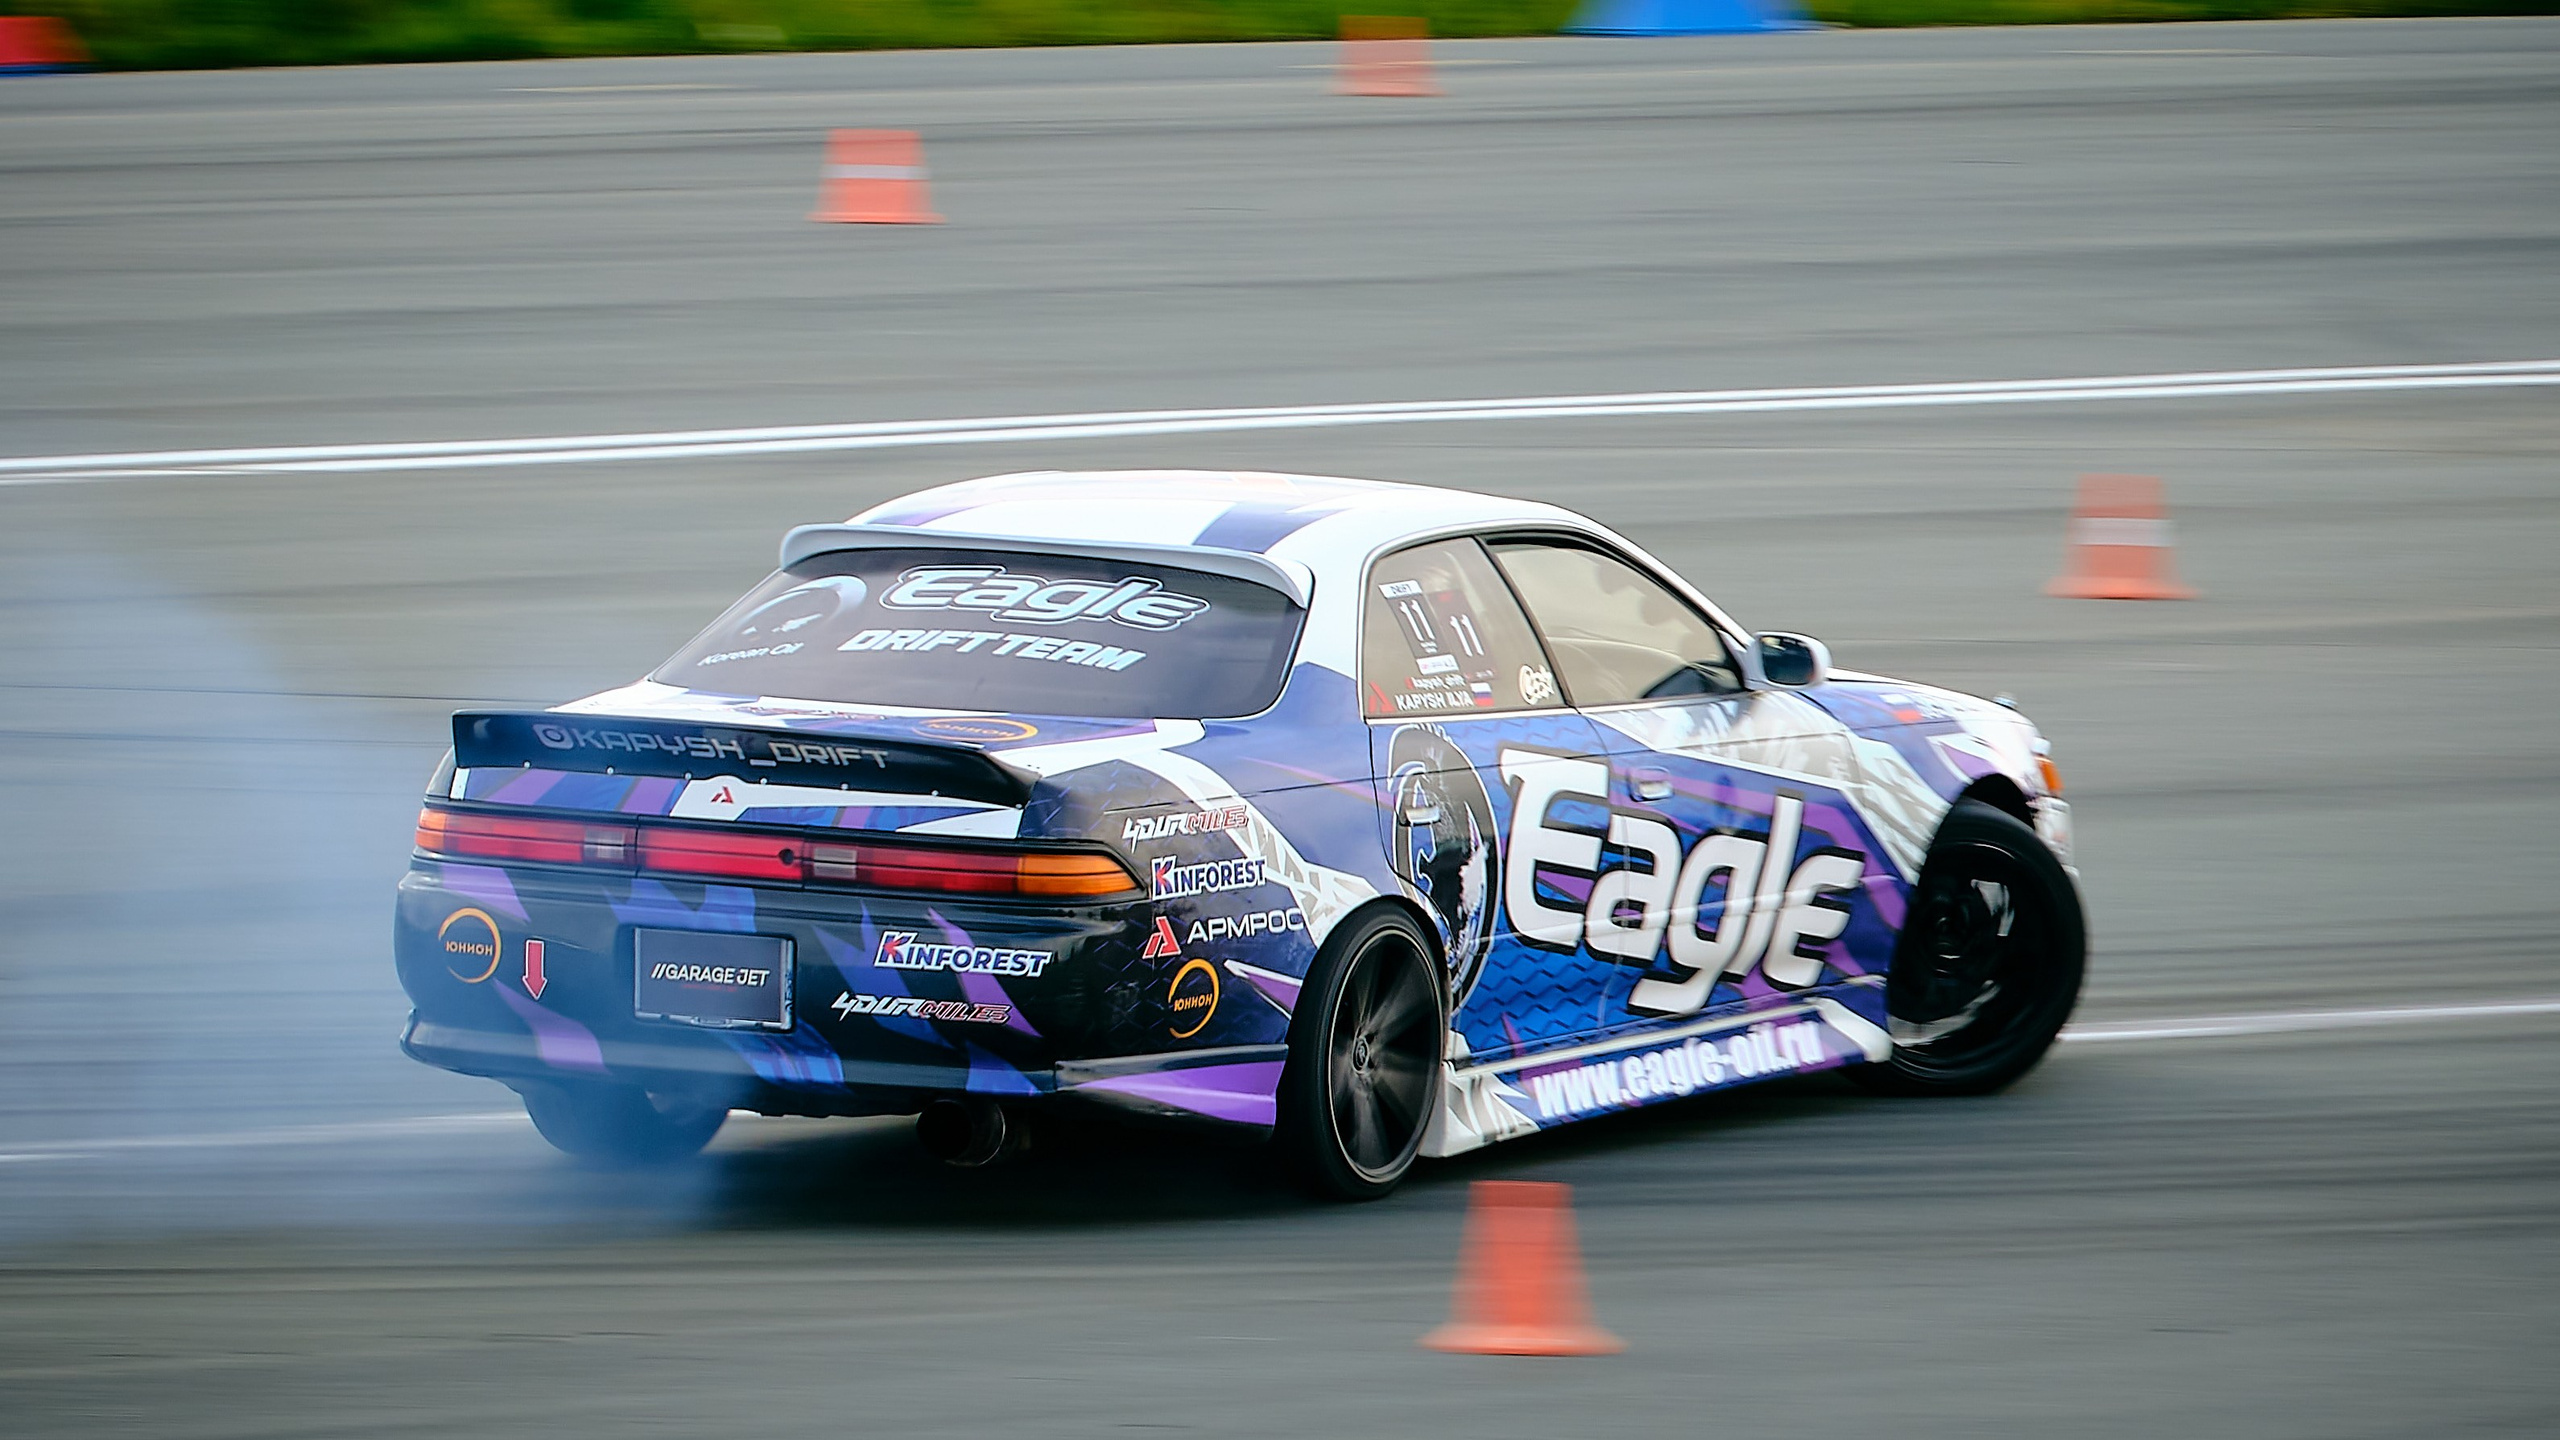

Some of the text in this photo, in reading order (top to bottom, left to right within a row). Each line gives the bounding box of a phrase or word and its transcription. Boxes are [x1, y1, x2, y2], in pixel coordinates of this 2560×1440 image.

[881, 566, 1209, 630] Eagle
[1399, 599, 1435, 641] 11
[1450, 614, 1484, 657] 11
[837, 629, 1146, 671] DRIFT TEAM
[1395, 690, 1475, 710] KAPYSH ILYA
[570, 727, 888, 768] KAPYSH_DRIFT
[1152, 856, 1267, 900] KINFOREST
[1499, 744, 1866, 1017] Eagle
[445, 940, 493, 956] ЮНИОН
[876, 932, 1051, 976] KINFOREST
[736, 968, 771, 987] JET
[1174, 993, 1213, 1012] ЮНИОН
[1533, 1020, 1826, 1118] www.eagle-oil.ru
